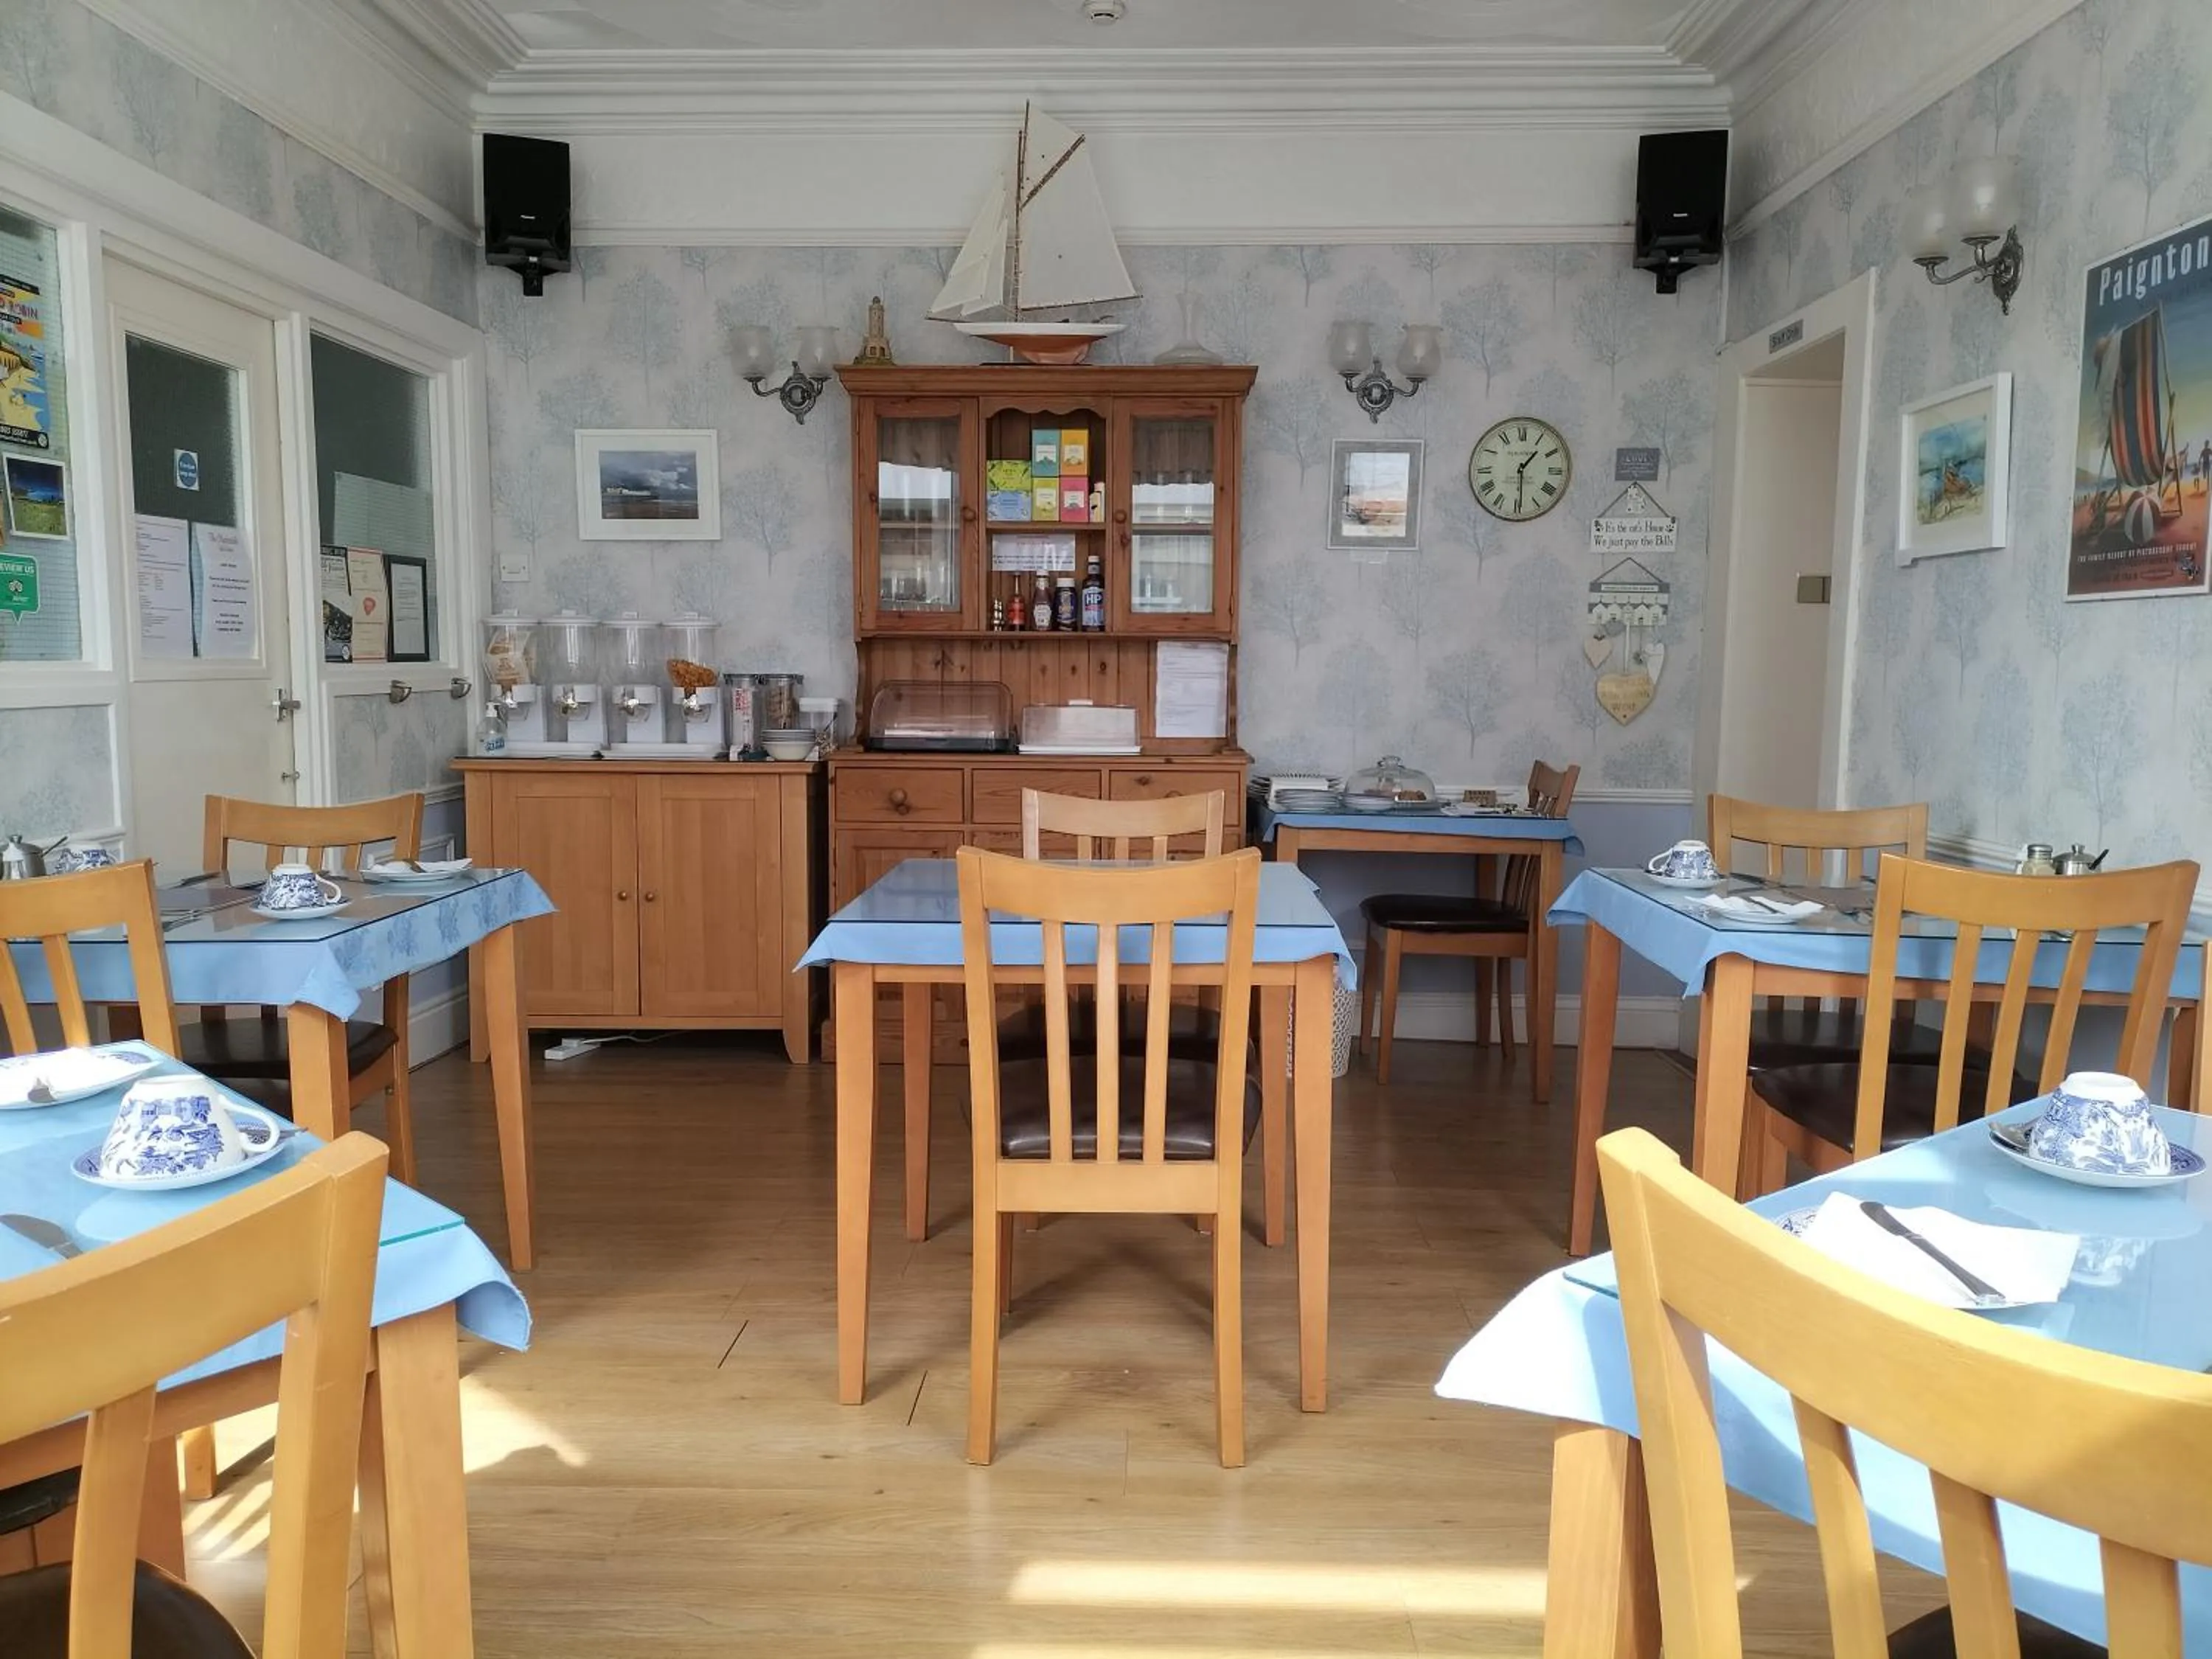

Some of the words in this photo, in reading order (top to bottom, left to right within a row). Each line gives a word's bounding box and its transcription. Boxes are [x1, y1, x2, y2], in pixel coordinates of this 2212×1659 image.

[2099, 235, 2210, 306] Paignton
[24, 565, 35, 574] US
[1086, 593, 1102, 604] HP
